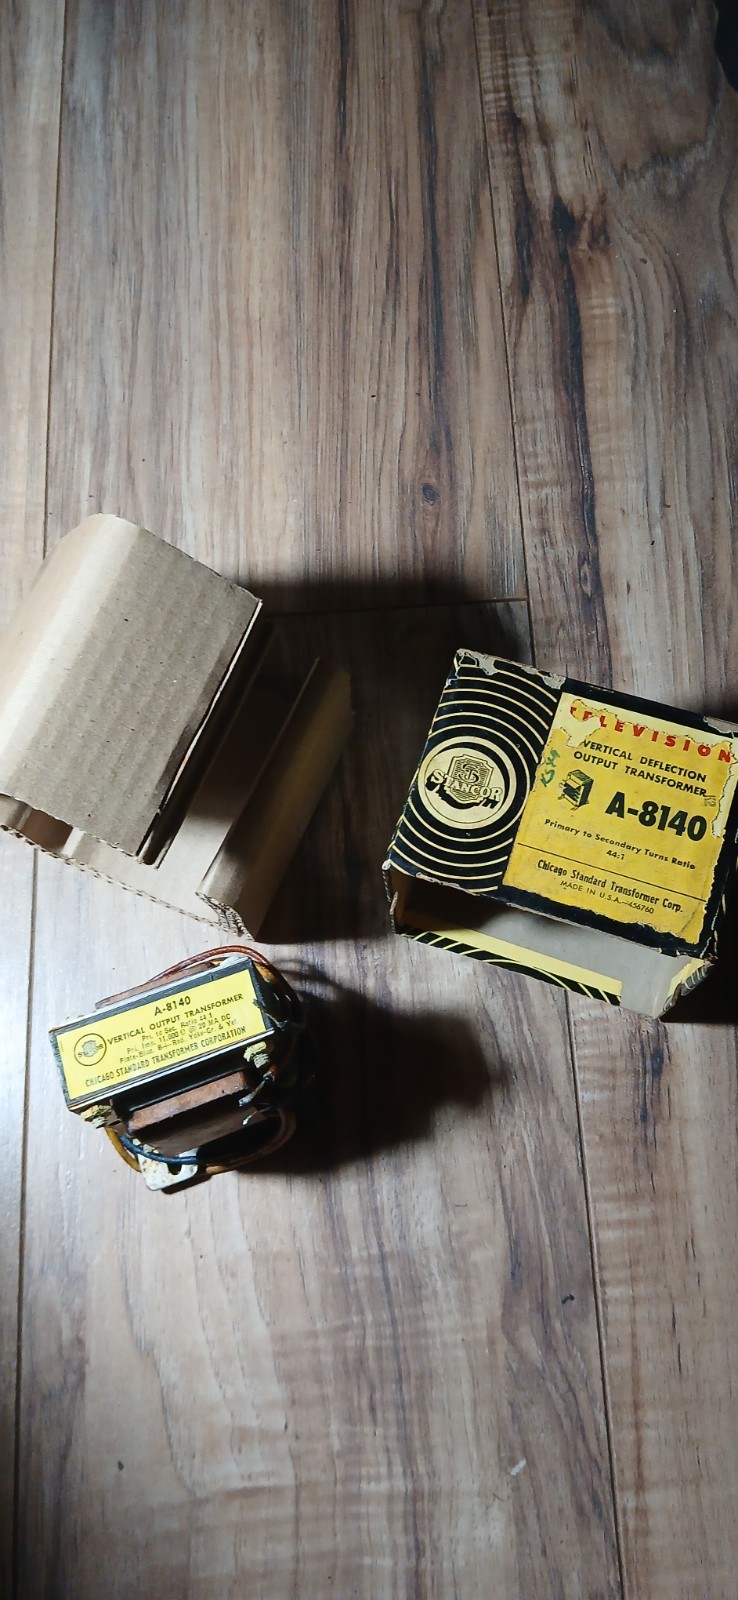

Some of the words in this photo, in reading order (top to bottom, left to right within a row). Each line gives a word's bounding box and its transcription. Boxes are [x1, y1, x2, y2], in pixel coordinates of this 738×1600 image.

[573, 750, 618, 770] OUTPUT
[625, 765, 707, 797] TRANSFORMER
[583, 739, 633, 761] VERTICAL
[639, 756, 707, 783] DEFLECTION
[431, 768, 503, 801] STANCOR
[605, 791, 707, 842] A-8140
[545, 818, 580, 836] Primary
[583, 830, 592, 838] to
[595, 834, 642, 855] Secondary
[644, 848, 668, 862] Turns
[672, 857, 696, 870] Ratio
[606, 850, 625, 860] 44:1
[537, 859, 567, 876] Chicago
[570, 869, 607, 888] Standard
[610, 881, 659, 905] Transformer
[662, 898, 683, 913] Corp.
[560, 880, 583, 892] MADE
[586, 885, 596, 896] IN
[107, 1027, 145, 1045] VERTICAL
[149, 1015, 180, 1031] OUTPUT
[184, 993, 244, 1018] TRANSFORMER
[154, 996, 191, 1017] A-8140
[221, 1013, 231, 1021] DC
[85, 1071, 114, 1087] CHICAGO
[116, 1060, 149, 1077] STANDARD
[151, 1042, 199, 1064] TRANSFORMER
[201, 1026, 246, 1048] CORPORATION
